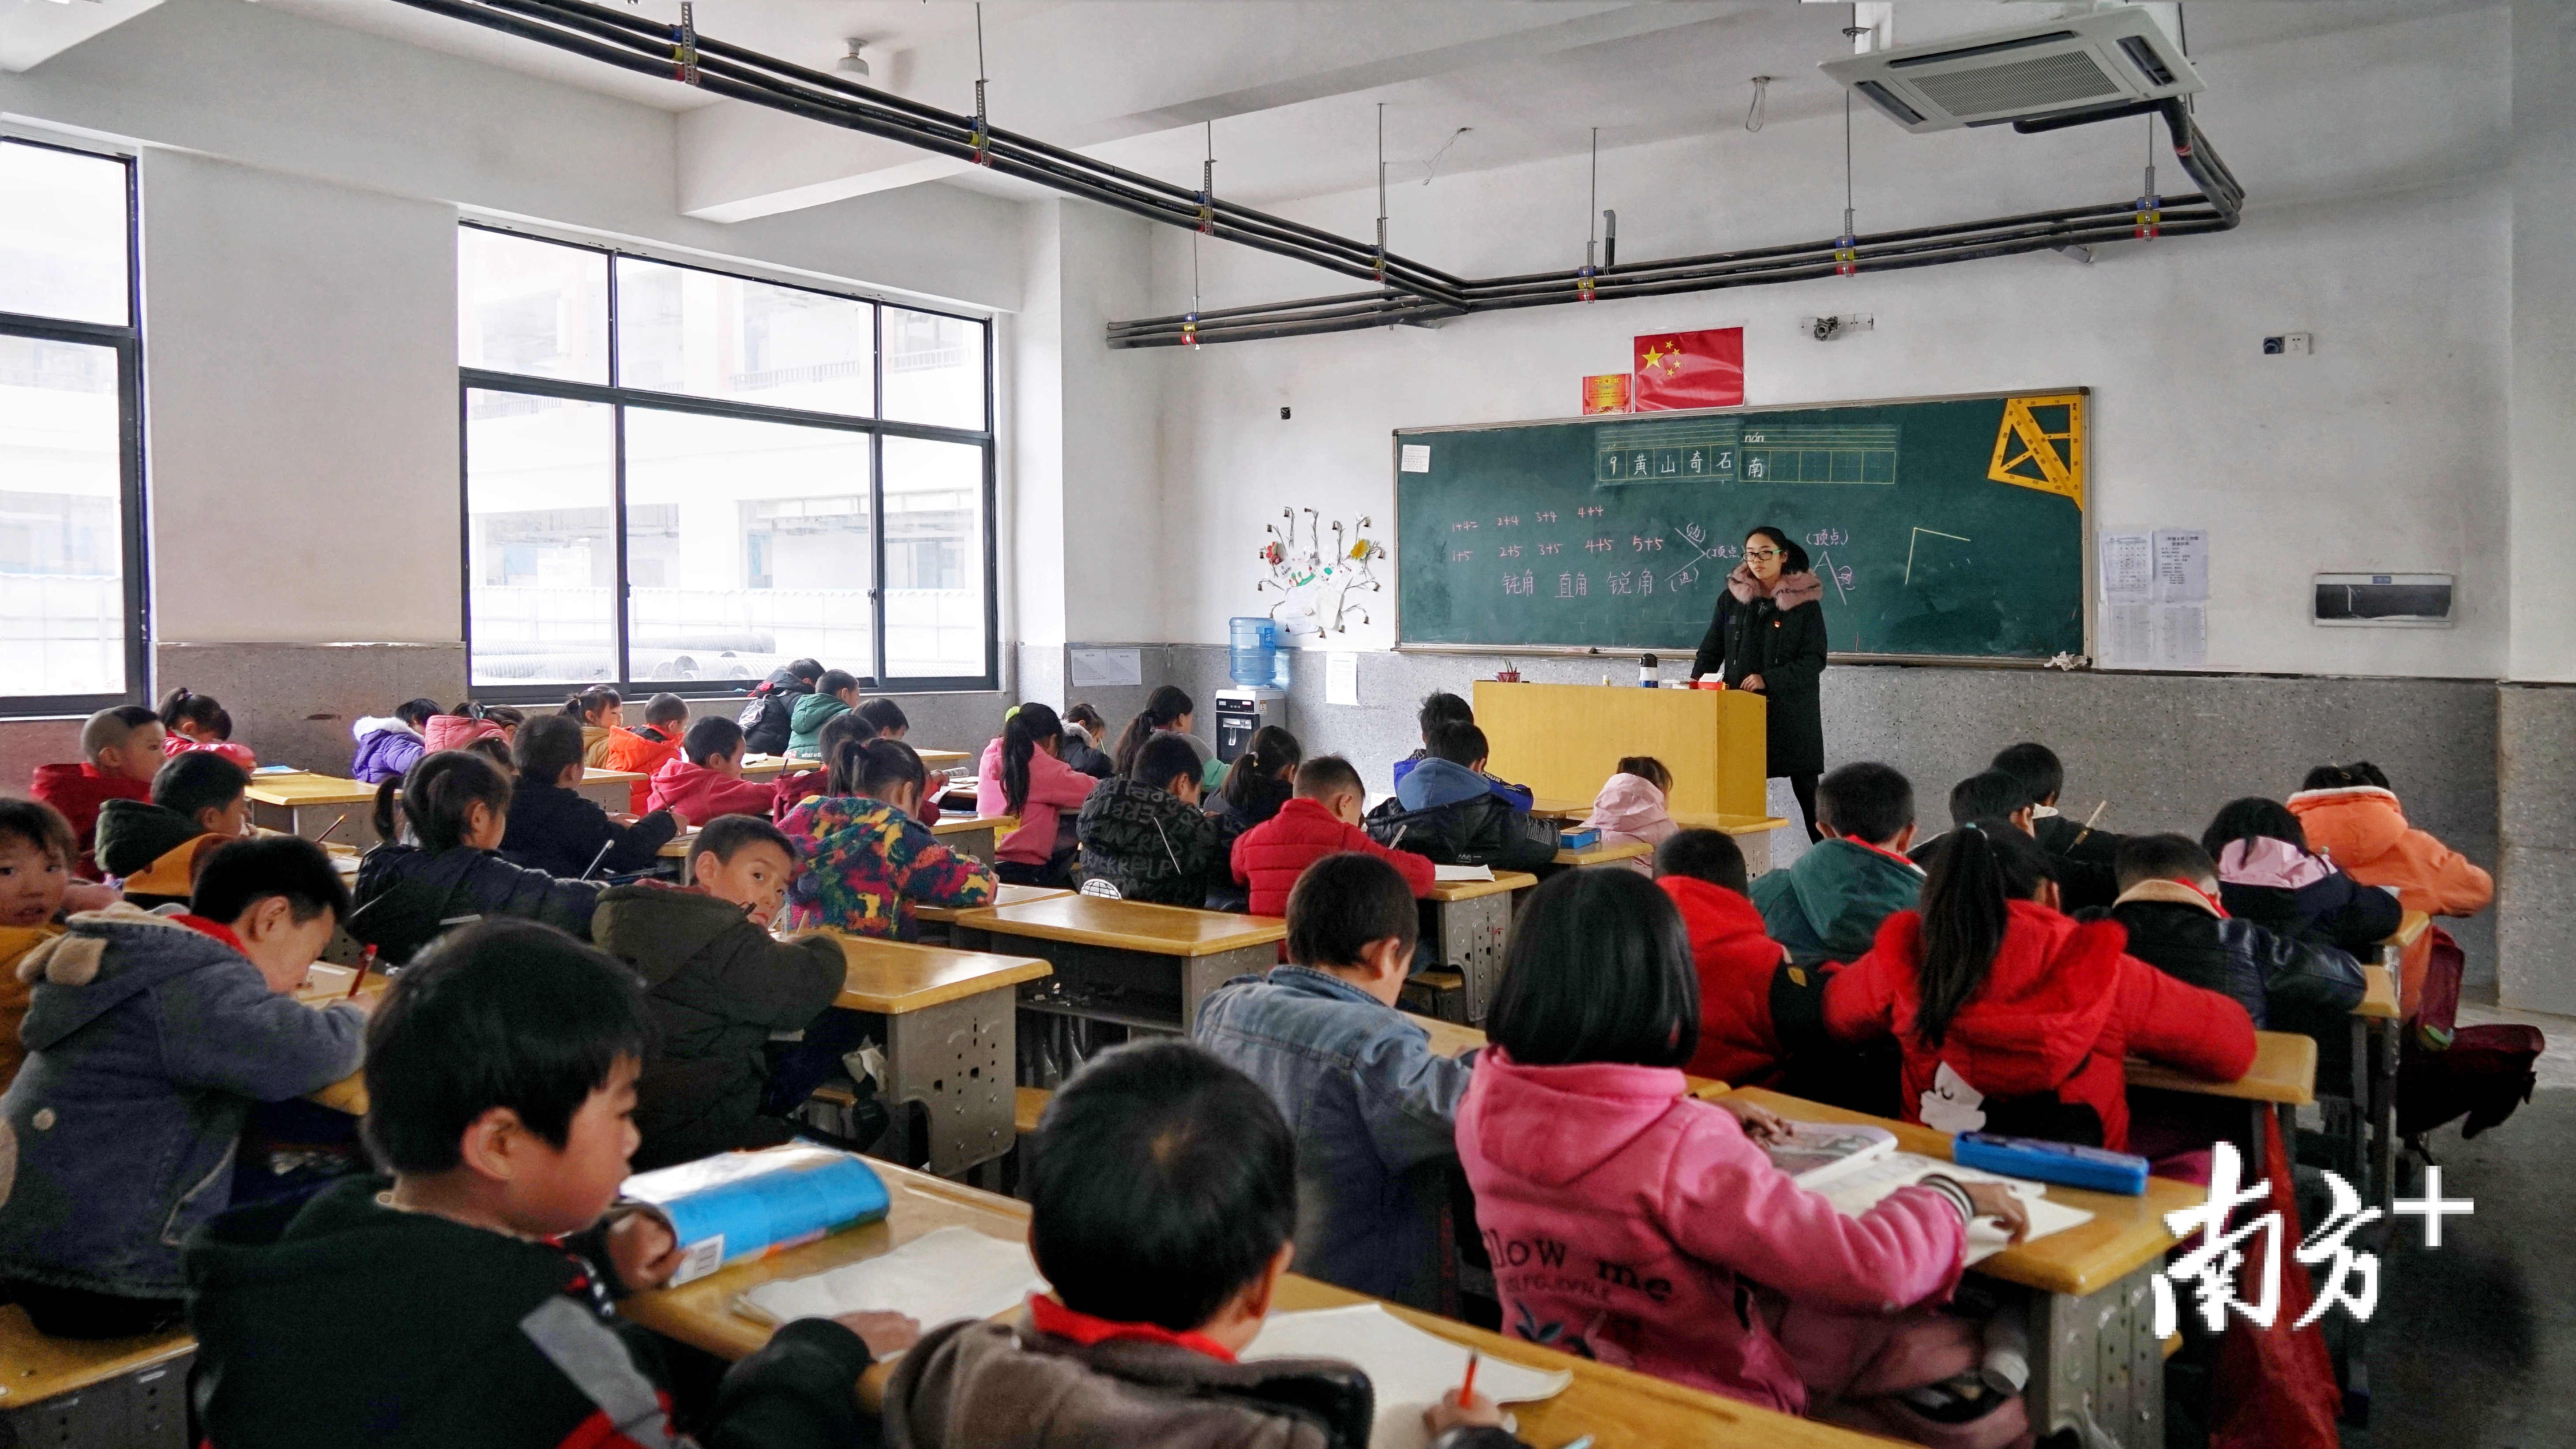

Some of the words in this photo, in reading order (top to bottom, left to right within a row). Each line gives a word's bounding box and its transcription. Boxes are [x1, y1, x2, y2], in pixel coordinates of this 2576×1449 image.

[1748, 457, 1762, 478] 南
[1497, 516, 1519, 526] 2+4
[1535, 511, 1558, 523] 3+4
[1578, 505, 1603, 518] 4+4
[1453, 550, 1472, 562] 1+5
[1500, 545, 1523, 557] 2+5
[1538, 543, 1563, 555] 3+5
[1585, 538, 1614, 554] 4+5
[1633, 535, 1663, 551] 5+5
[1806, 528, 1848, 546] (顶点)
[1501, 568, 1533, 596] 钝角
[1555, 570, 1587, 598] 直角
[1606, 568, 1652, 597] 锐角
[1595, 1259, 1672, 1303] me
